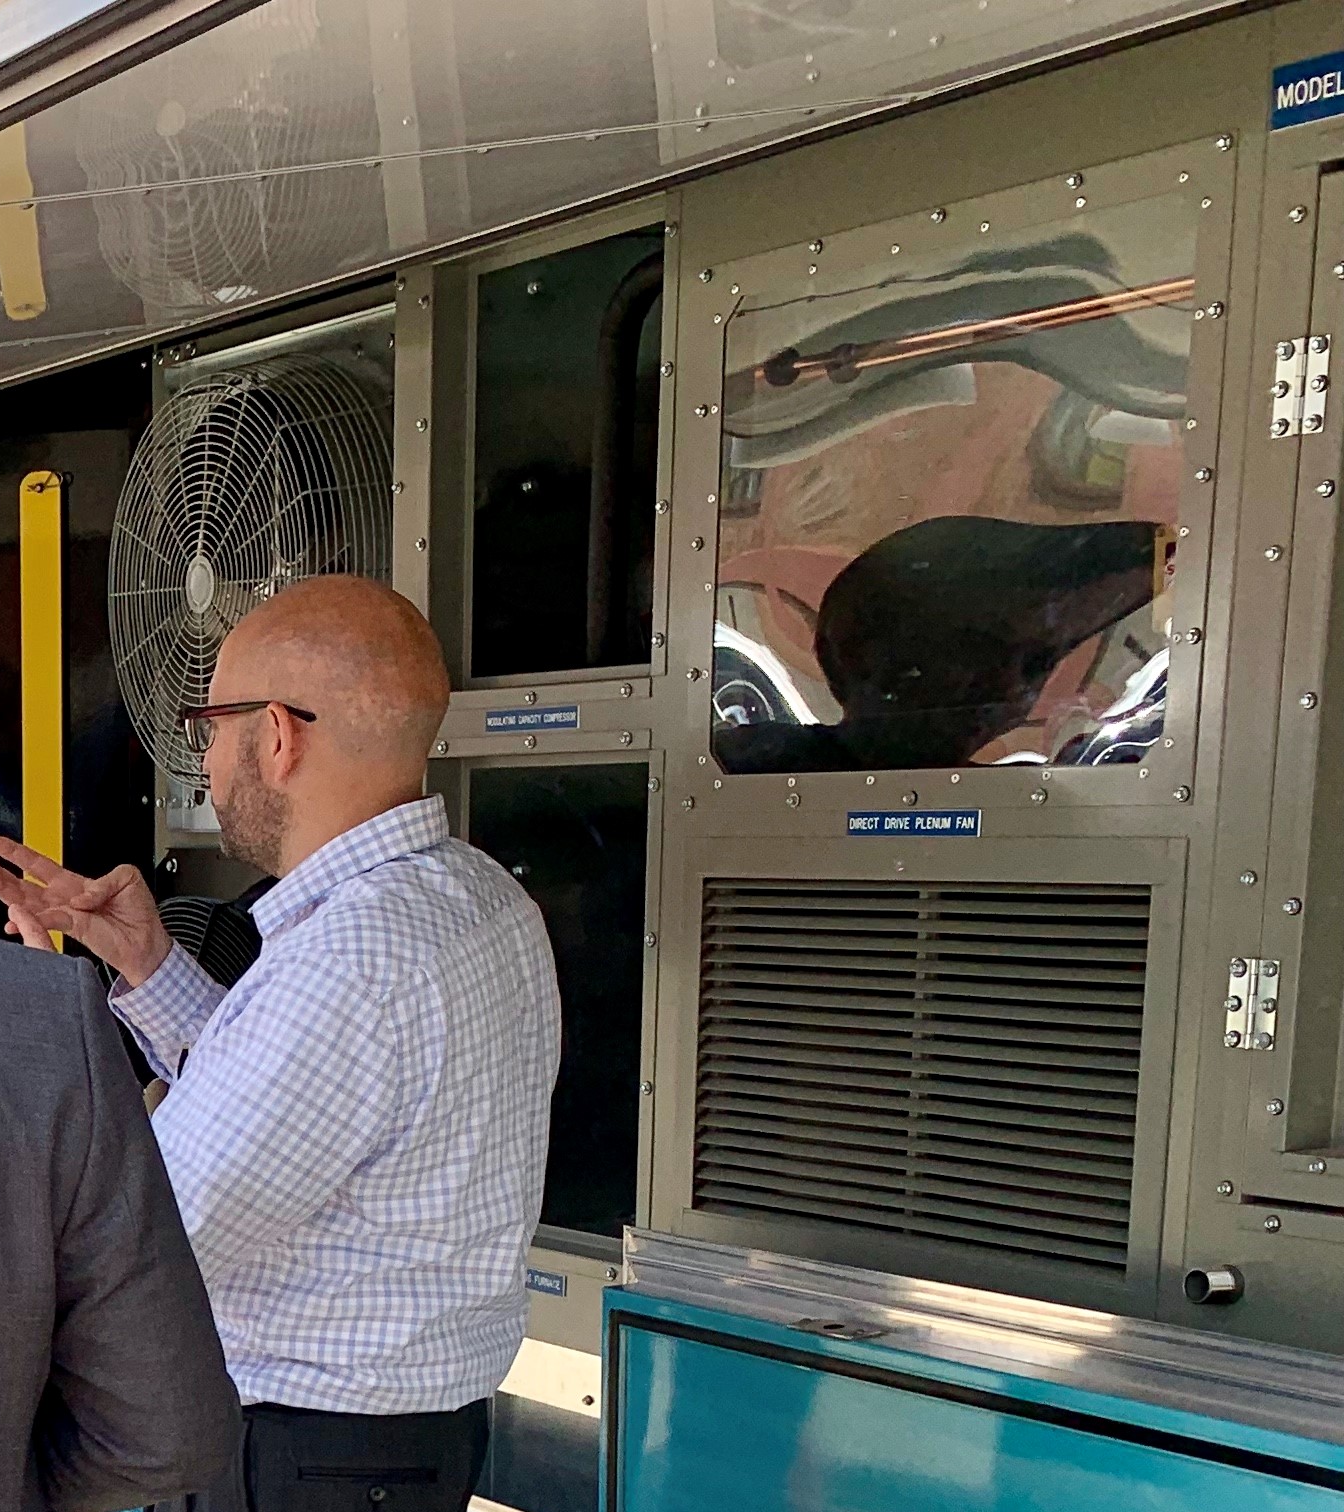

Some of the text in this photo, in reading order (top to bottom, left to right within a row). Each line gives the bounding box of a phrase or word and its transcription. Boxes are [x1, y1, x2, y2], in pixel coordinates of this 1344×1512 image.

[1277, 71, 1344, 110] MODEL
[543, 711, 576, 723] COMPRESSOR
[849, 817, 974, 829] DIRECT DRIVE PLENUM FAN
